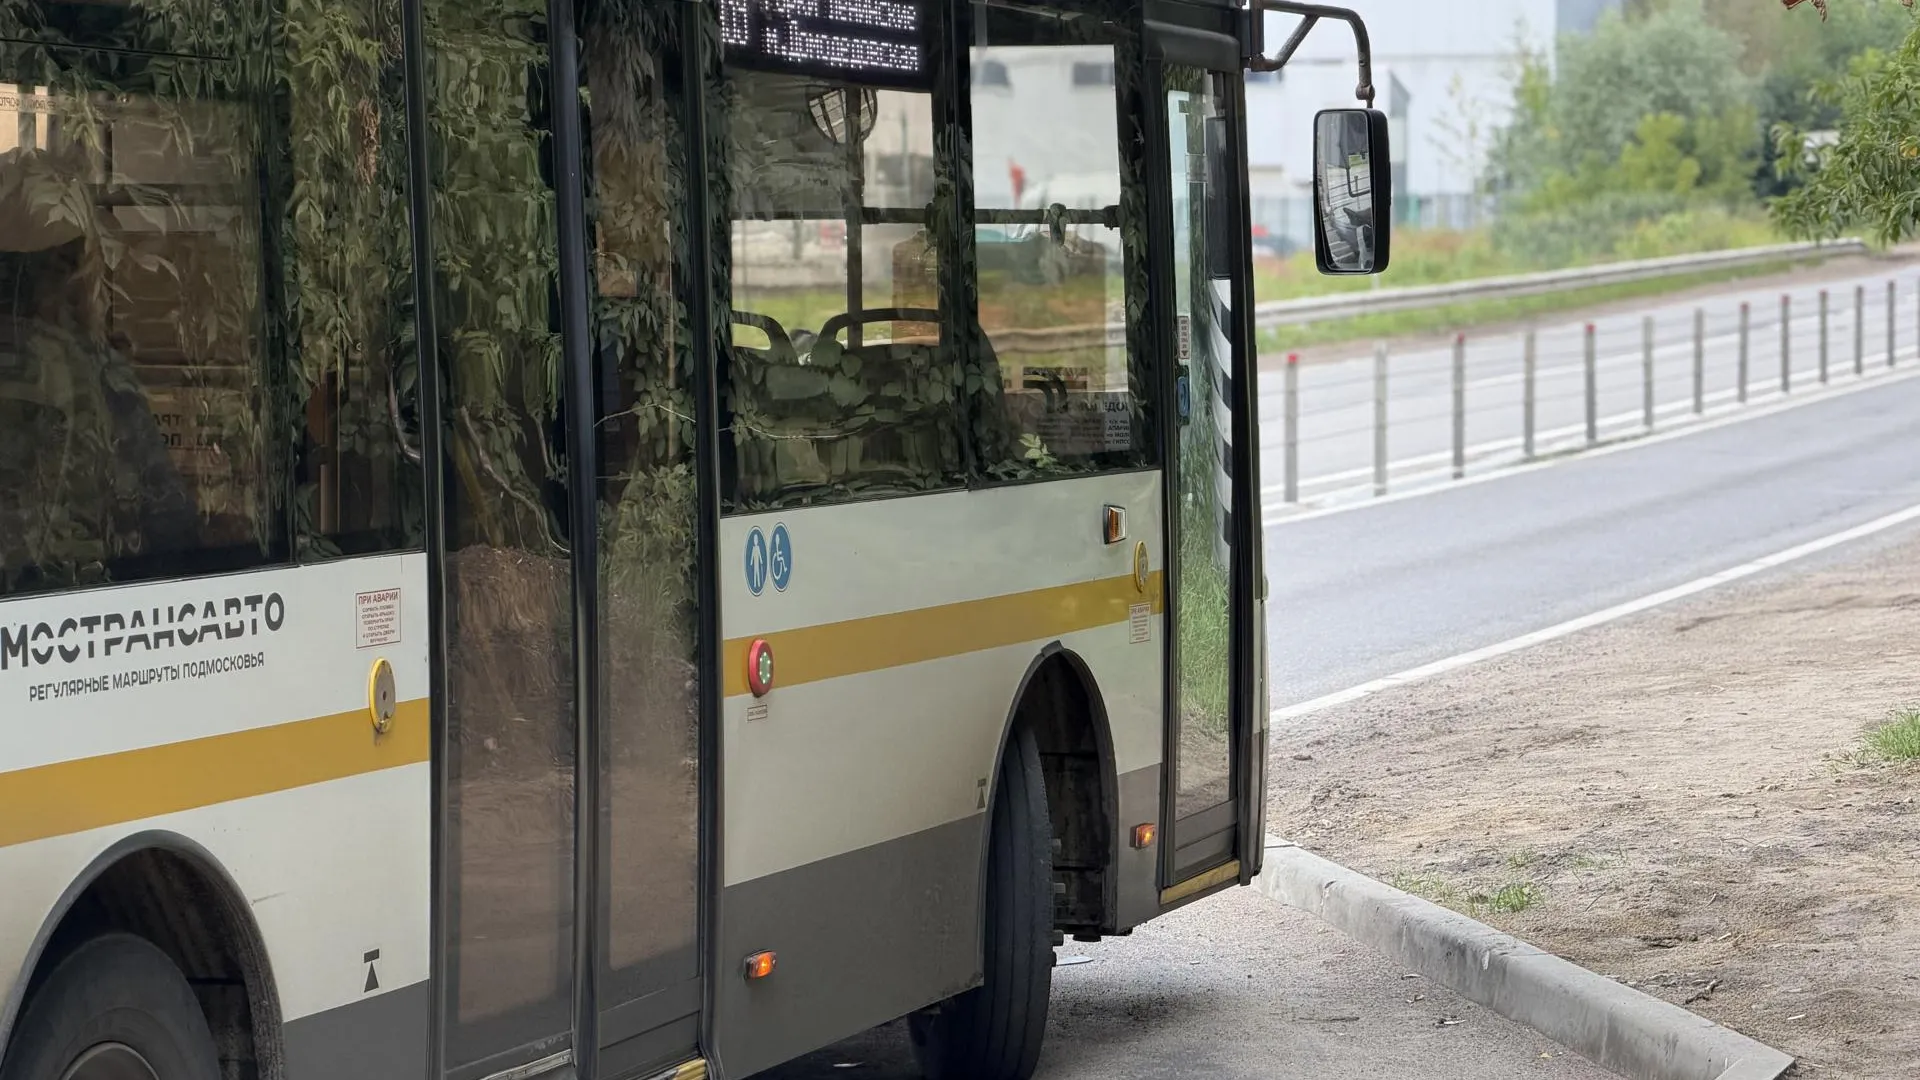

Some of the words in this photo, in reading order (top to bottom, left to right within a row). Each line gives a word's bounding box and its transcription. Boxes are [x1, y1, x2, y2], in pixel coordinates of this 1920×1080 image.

[372, 591, 399, 603] АВАРИИ
[0, 591, 286, 671] МОСТРАНСАВТО
[29, 675, 110, 702] РЕГУЛЯРНЫЕ
[112, 664, 181, 691] МАРШРУТЫ
[183, 651, 265, 679] ПОДМОСКОВЬЯ
